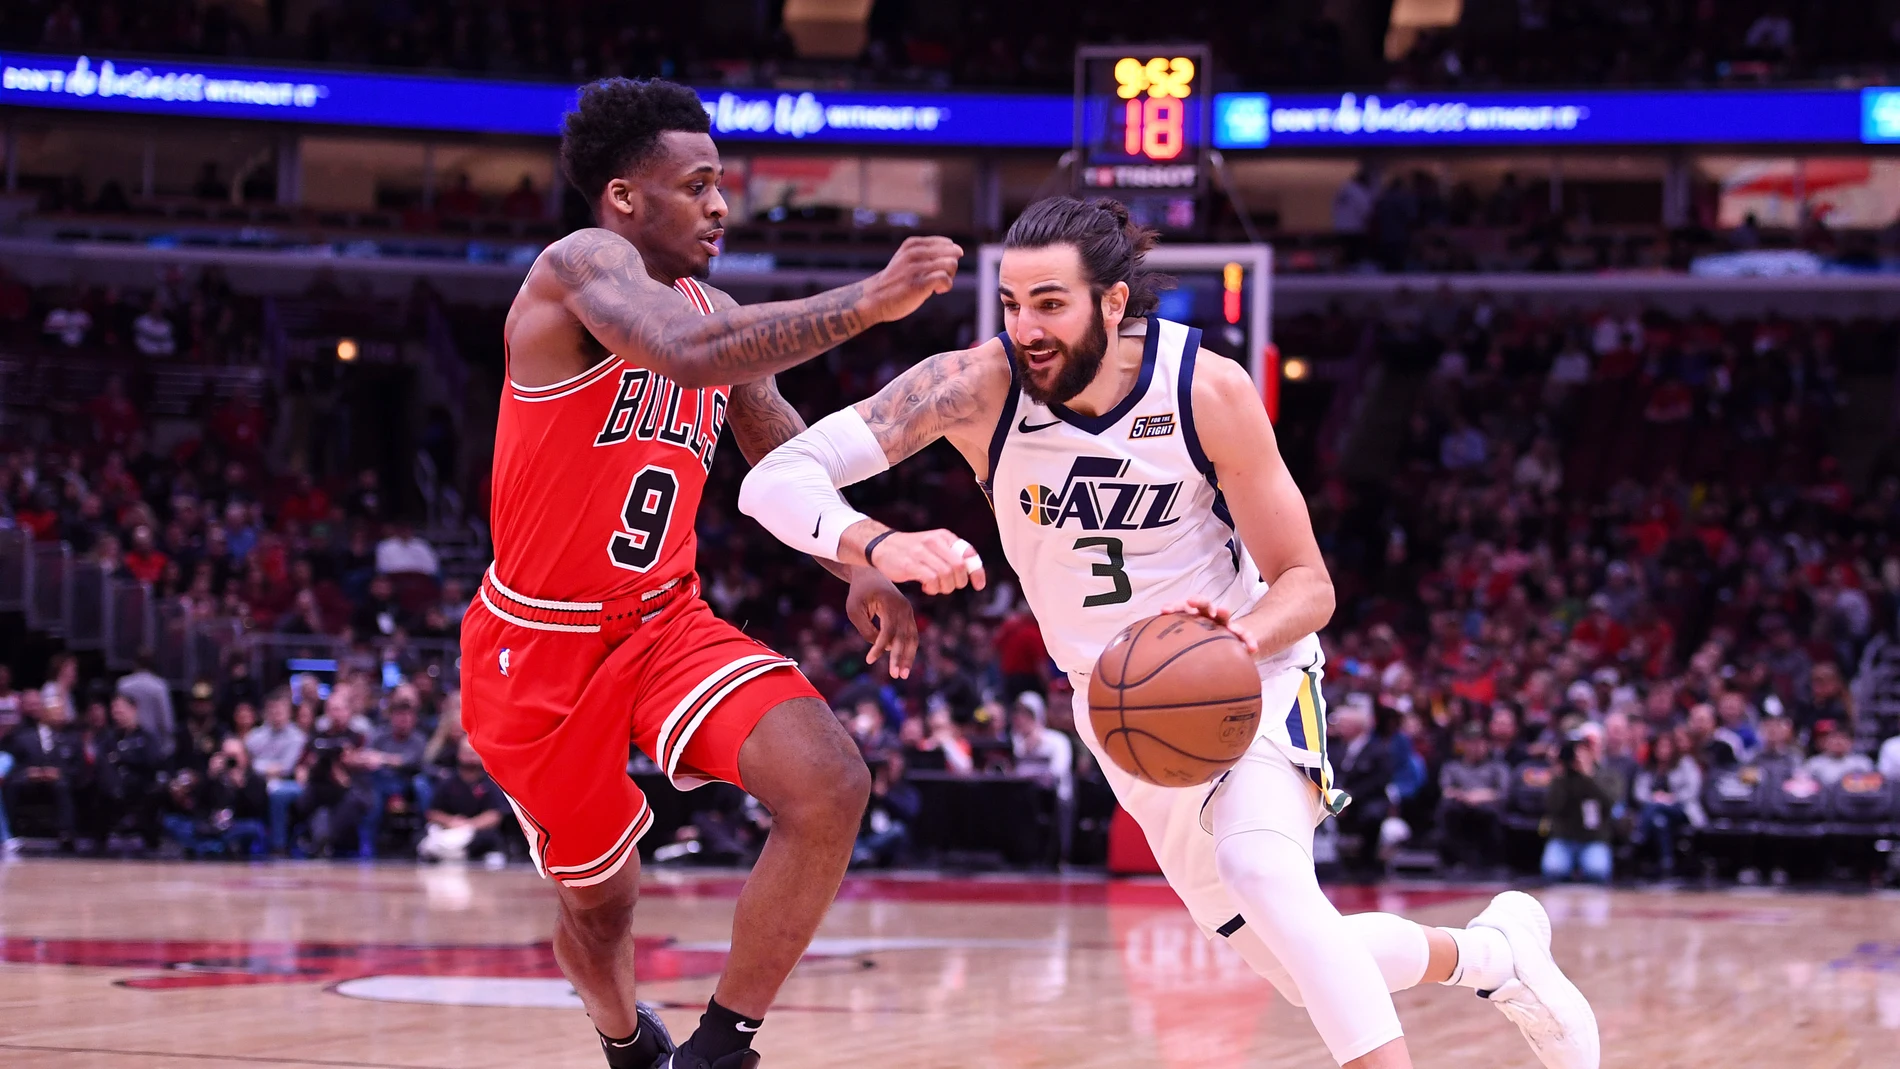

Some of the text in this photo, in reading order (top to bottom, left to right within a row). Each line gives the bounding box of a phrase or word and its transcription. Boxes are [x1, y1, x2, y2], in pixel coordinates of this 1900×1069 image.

[1125, 97, 1184, 160] 18
[1132, 417, 1147, 438] 5
[1145, 424, 1174, 437] FIGHT
[606, 464, 679, 573] 9
[1072, 536, 1133, 608] 3
